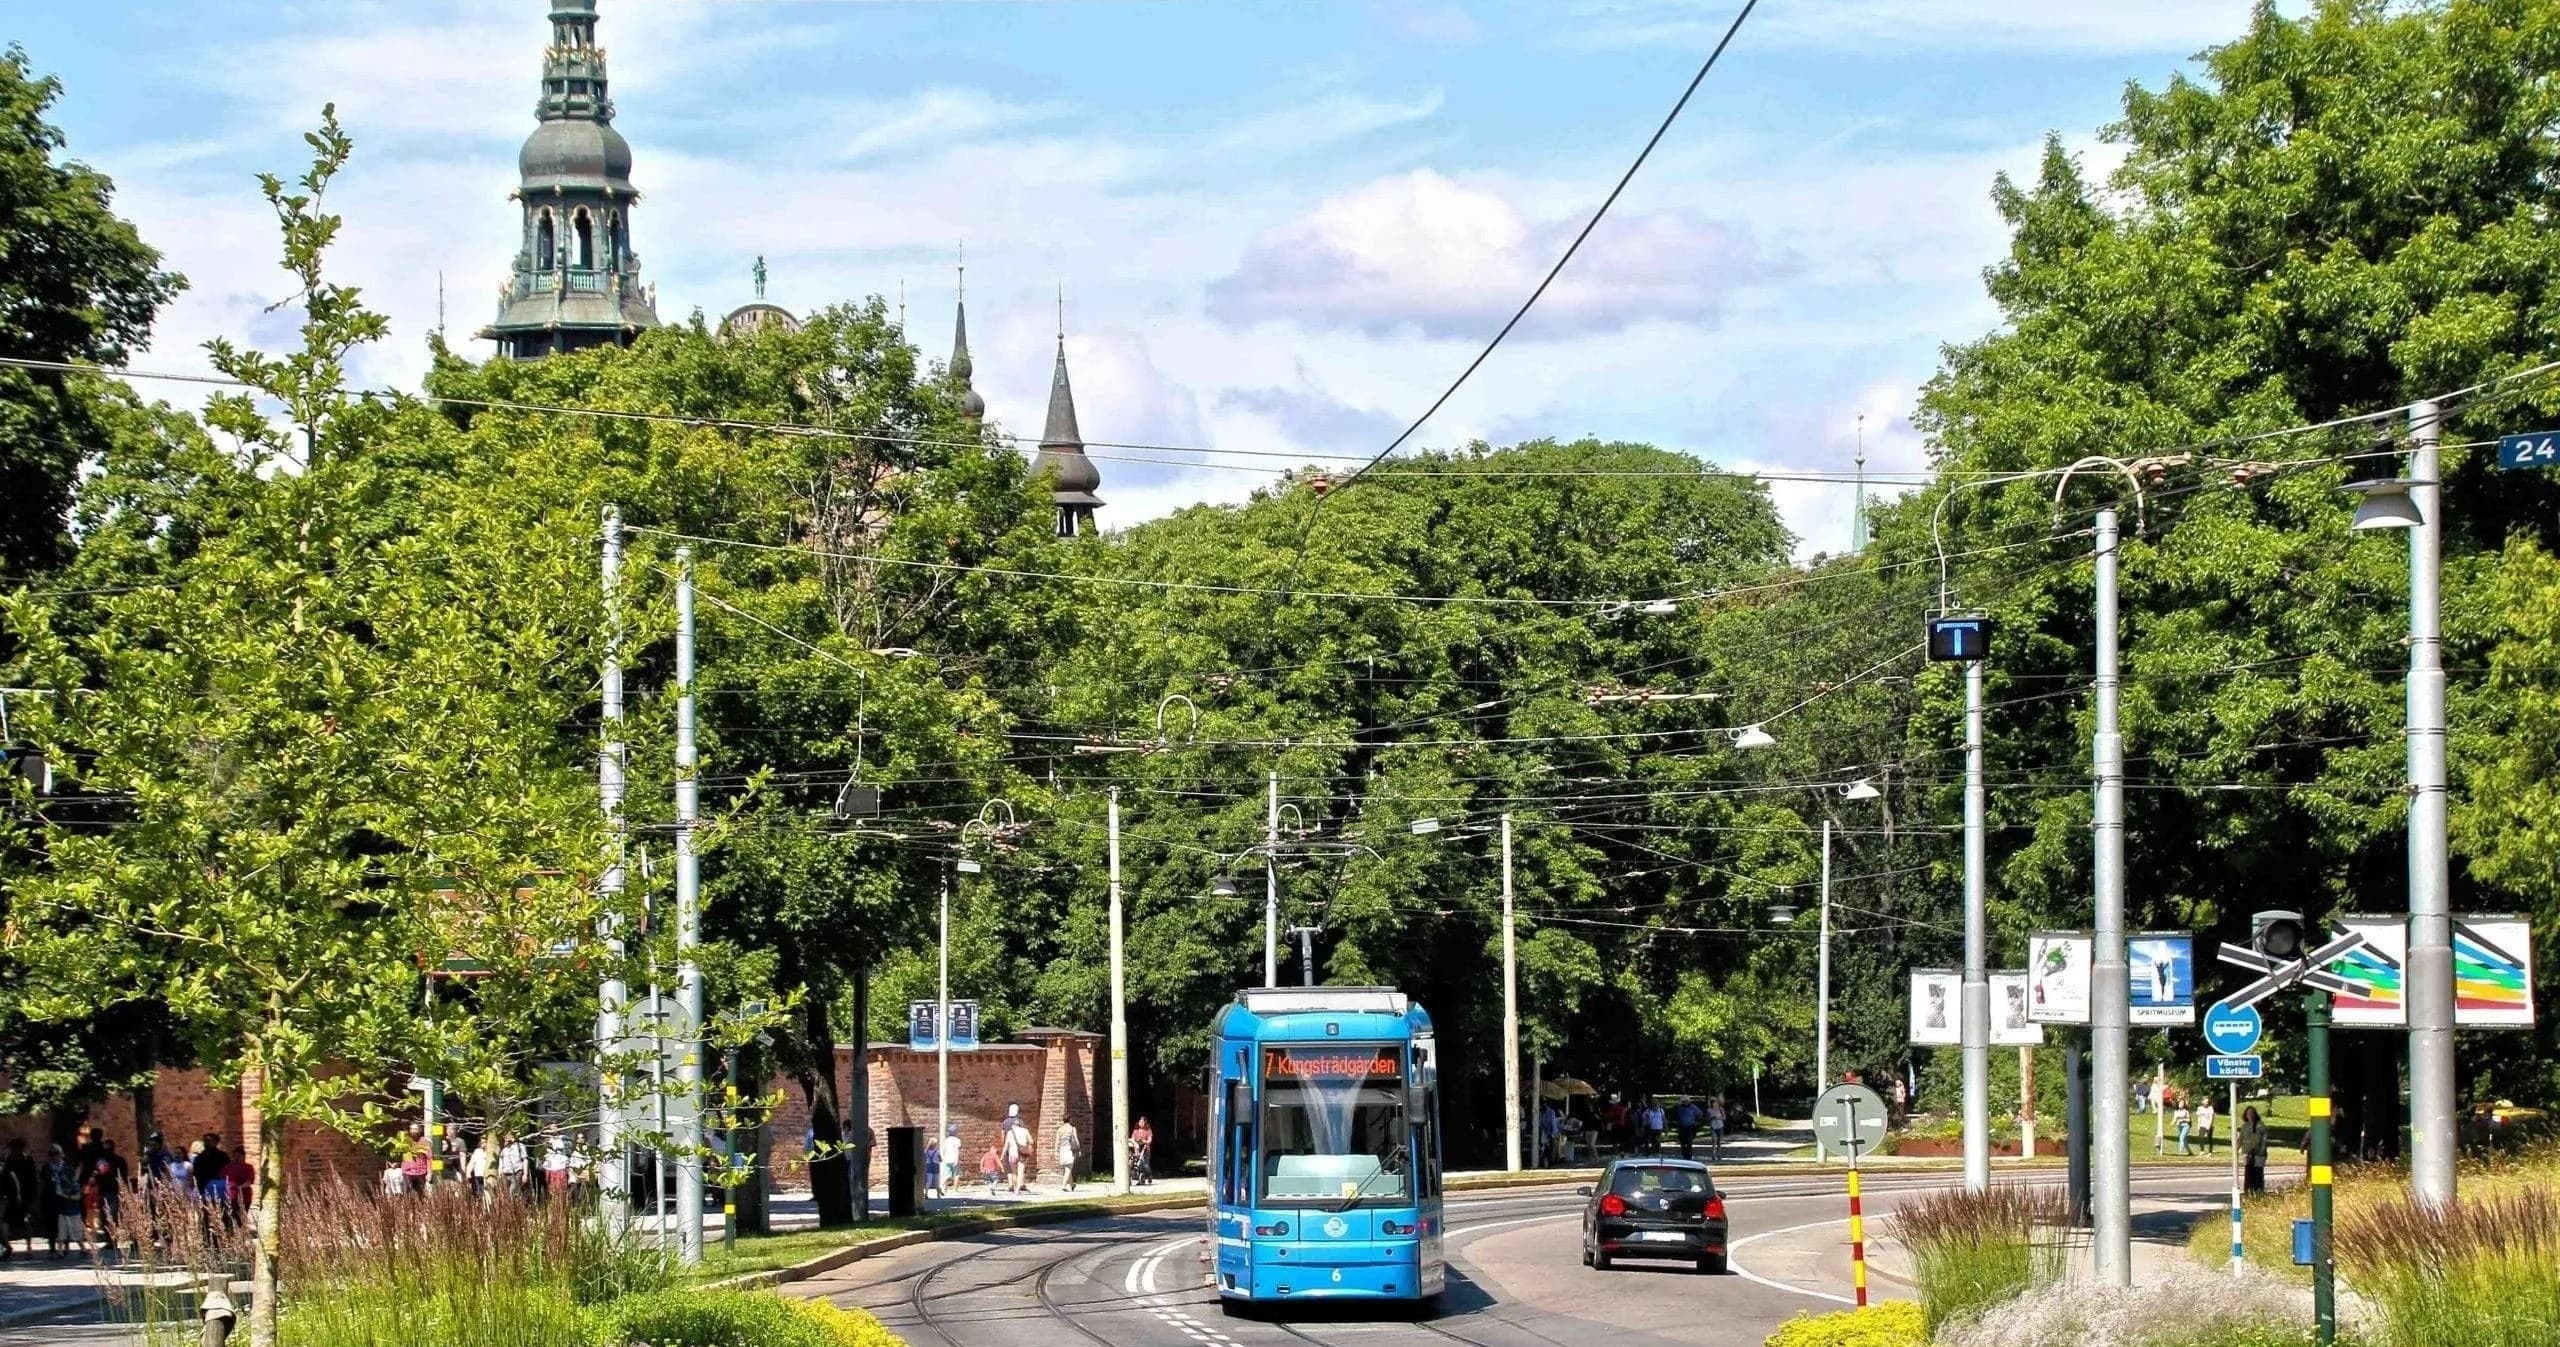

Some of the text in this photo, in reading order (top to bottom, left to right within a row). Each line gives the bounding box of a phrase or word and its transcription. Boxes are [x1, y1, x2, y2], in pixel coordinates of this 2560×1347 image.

[2515, 438, 2555, 462] 24
[1265, 1052, 1395, 1078] 7 Kungsträdgården
[1331, 1268, 1341, 1281] 6
